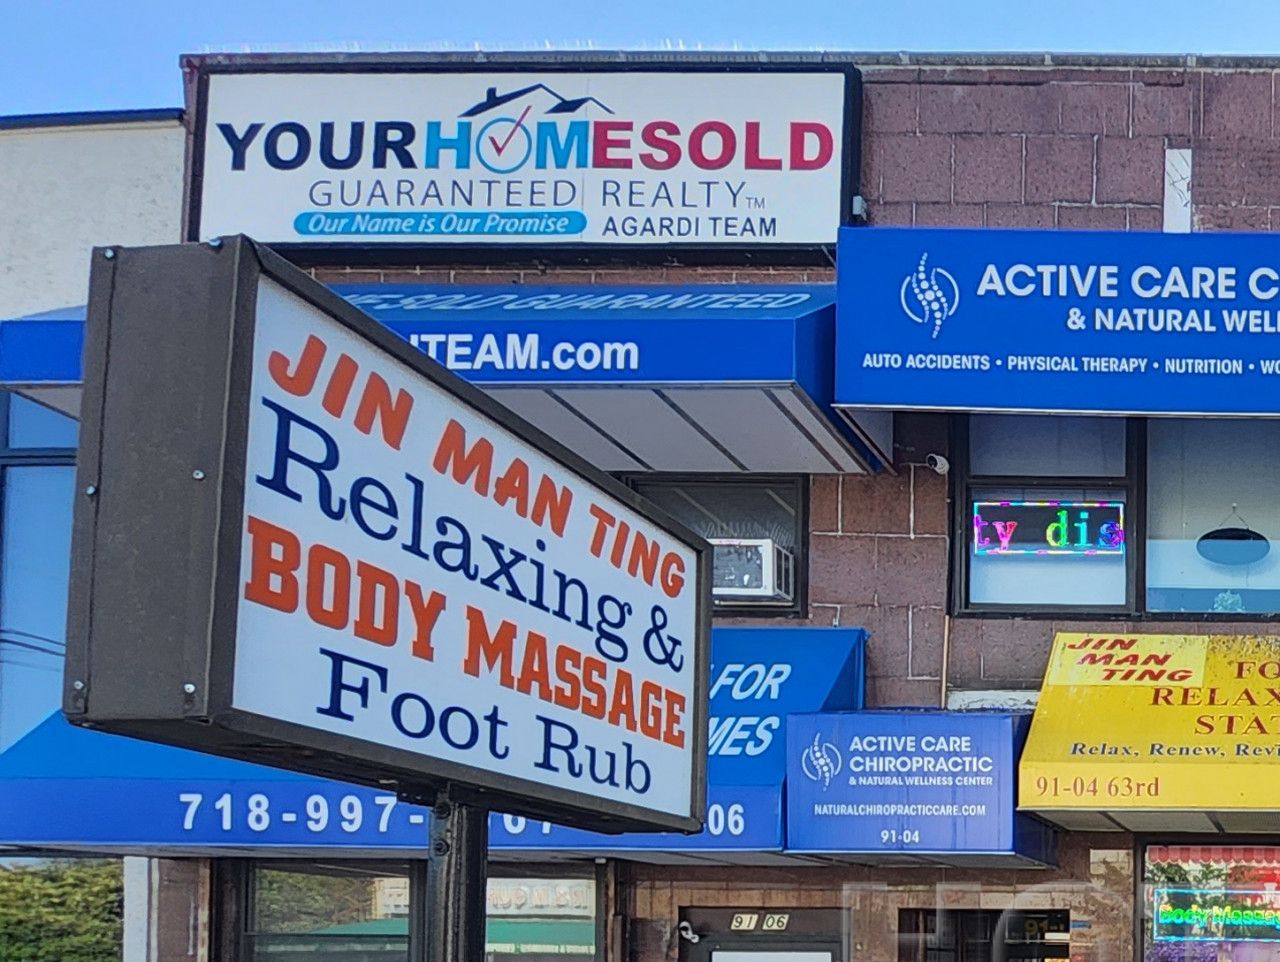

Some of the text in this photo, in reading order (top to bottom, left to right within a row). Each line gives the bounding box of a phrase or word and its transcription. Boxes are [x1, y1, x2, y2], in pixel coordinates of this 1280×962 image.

[216, 118, 834, 173] YOURHOMESOLD
[309, 179, 746, 208] GUARANTEED REALTY
[309, 213, 569, 235] Our Name is Our Promise
[602, 216, 777, 238] AGARDI TEAM
[976, 264, 1120, 299] ACTIVE
[1131, 265, 1238, 301] CARE
[1067, 308, 1086, 330] &
[1094, 308, 1215, 332] NATURAL
[863, 353, 902, 369] AUTO
[905, 354, 990, 371] ACCIDENTS
[1008, 355, 1078, 372] PHYSICAL
[1081, 356, 1148, 373] THERAPY
[1164, 358, 1243, 374] NUTRITION
[268, 334, 685, 599] JIN MAN TING
[256, 397, 683, 673] Relaxing &
[245, 515, 685, 750] BODY MASSAGE
[1067, 638, 1193, 682] JIN MAN TING
[710, 664, 792, 700] FOR
[317, 648, 652, 795] Foot Rub
[849, 736, 971, 752] ACTIVE CARE
[1070, 742, 1140, 759] Relax,
[1149, 742, 1230, 759] Renew,
[849, 756, 993, 773] CHIROPRACTIC
[859, 776, 993, 787] NATURAL WELLNESS CENTER
[1036, 775, 1160, 799] 91-04 63rd
[814, 804, 986, 817] NATURALCHIROPRACTICCARE.COM
